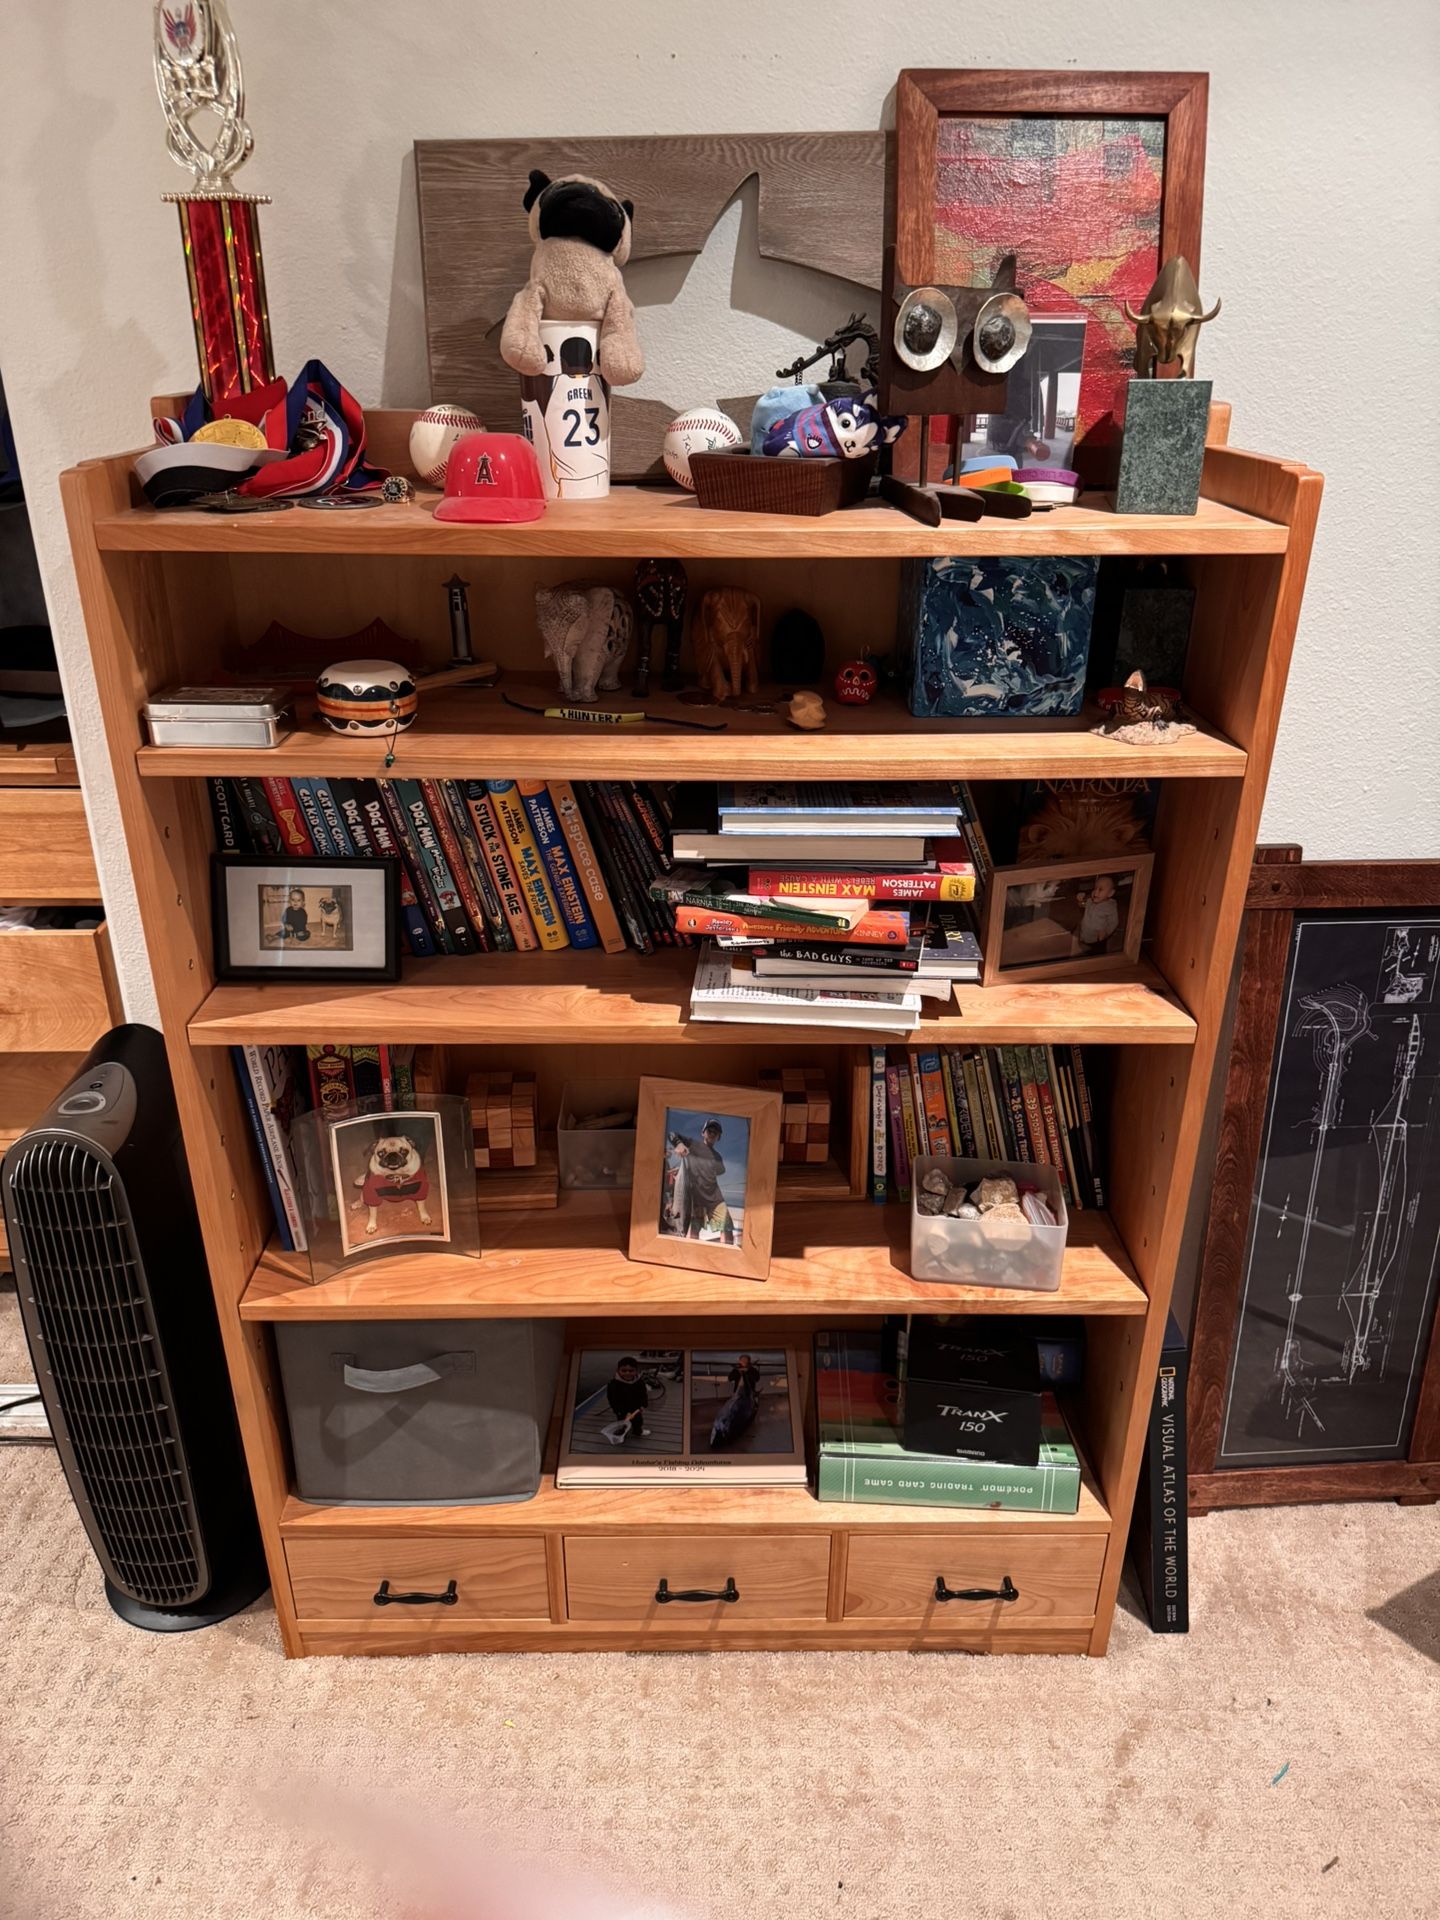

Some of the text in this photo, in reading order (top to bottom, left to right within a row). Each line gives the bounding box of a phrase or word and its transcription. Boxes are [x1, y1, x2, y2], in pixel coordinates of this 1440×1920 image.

[567, 388, 593, 401] GREEN
[562, 408, 600, 447] 23
[475, 452, 495, 485] A
[568, 710, 614, 724] HUNTER
[299, 788, 314, 807] CAT
[316, 789, 332, 808] CAT
[1033, 778, 1152, 797] NARNIA
[214, 778, 235, 847] SCOTT CARD
[341, 799, 362, 825] DOG
[364, 801, 384, 826] DOG
[500, 800, 520, 845] PATTERSON
[511, 808, 526, 834] JAMES
[528, 799, 549, 845] PATTERSON
[541, 807, 556, 833] JAMES
[350, 825, 371, 847] MAN
[409, 801, 437, 849] DOG MAN
[373, 827, 393, 849] MAN
[475, 803, 497, 841] STUCK
[492, 854, 514, 891] STONE
[505, 893, 522, 916] AGE
[569, 825, 604, 902] space case
[518, 860, 543, 916] SAVES THE FUTURE
[521, 847, 556, 926] MAX EINSTEIN
[551, 845, 570, 876] MAX
[562, 876, 586, 925] EINSTEIN
[779, 882, 876, 896] MAX EINSTEIN
[780, 874, 876, 884] REBELS WITH A CAUSE
[882, 878, 937, 889] PATTERSON
[685, 896, 713, 907] NARNIA
[893, 888, 925, 897] JAMES
[557, 887, 576, 925] EXPERIMENT
[711, 918, 734, 926] Rowley
[742, 923, 774, 931] Awesome
[775, 923, 807, 934] Friendly
[938, 913, 965, 944] DIARY
[780, 949, 794, 958] the
[796, 951, 820, 961] BAD
[821, 952, 853, 964] GUYS
[1034, 1139, 1046, 1165] TREEHO
[960, 1353, 989, 1363] 150
[1161, 1377, 1169, 1408] GEOGRAPHIC
[959, 1421, 986, 1433] 150
[663, 1459, 690, 1467] Fishing
[864, 1478, 894, 1487] GAME
[898, 1480, 925, 1489] CARD
[930, 1482, 974, 1491] TRADING
[1162, 1414, 1178, 1599] VISUAL ATLAS OF THE WORLD
